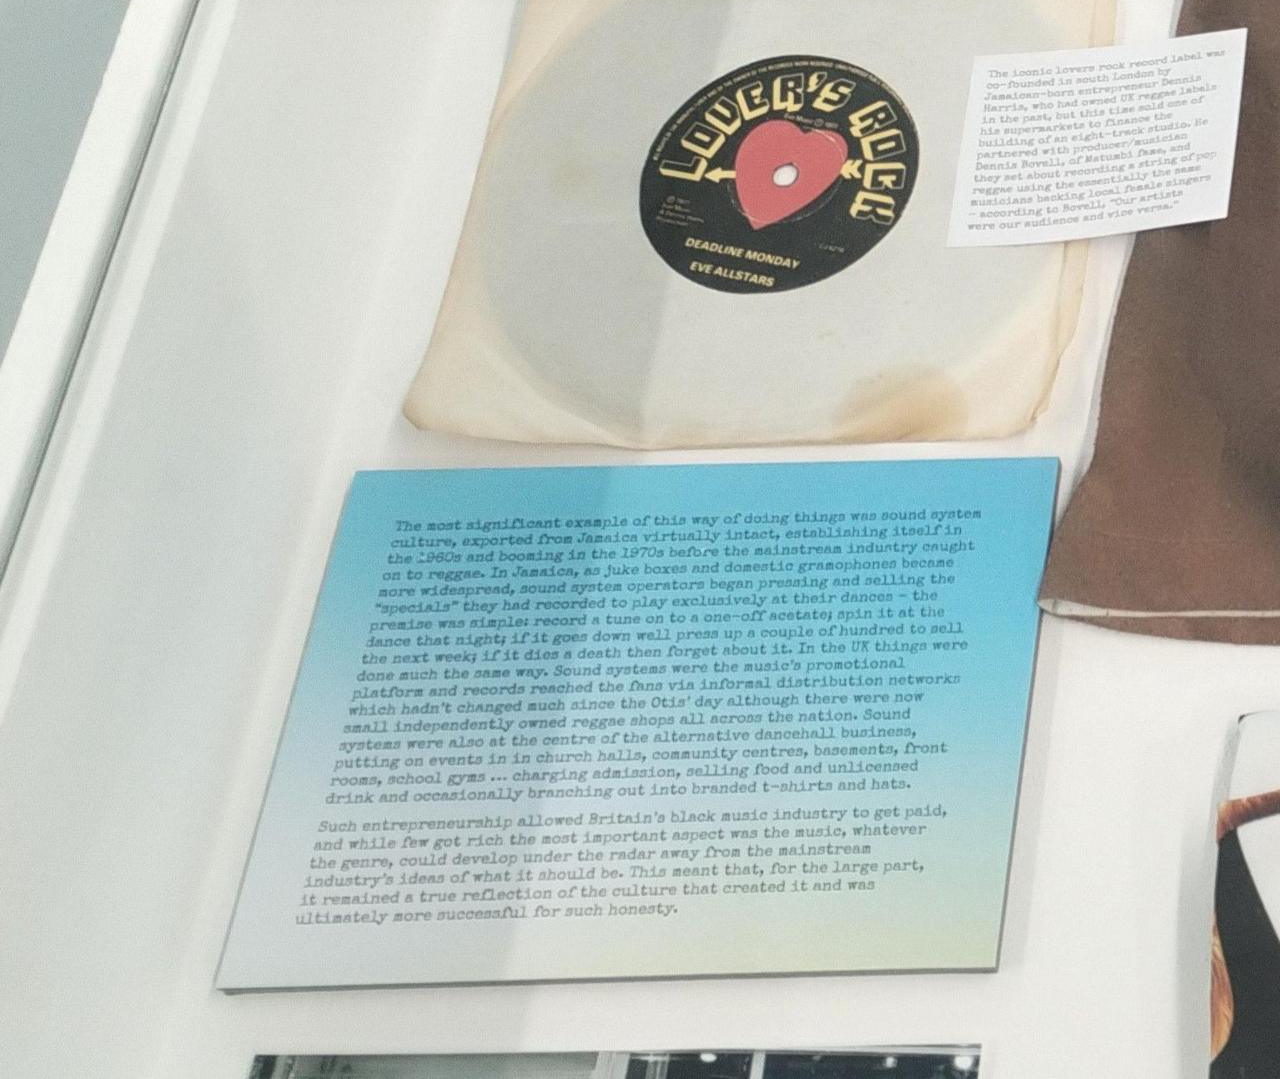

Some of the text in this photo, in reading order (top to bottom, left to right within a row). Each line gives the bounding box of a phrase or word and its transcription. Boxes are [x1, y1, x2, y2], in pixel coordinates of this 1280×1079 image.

[659, 71, 907, 226] LOVER'S ROCK
[685, 237, 801, 269] DEADLINE MONDAY
[689, 261, 776, 288] EVE ALLSTARS
[390, 523, 963, 549] culture, exported from Jamaica virtually intact, establishing itself in
[317, 803, 948, 834] Such entrepreneurship allowed Britain's black music industry to get paid,
[295, 902, 678, 926] ultimately more successful for such honesty.
